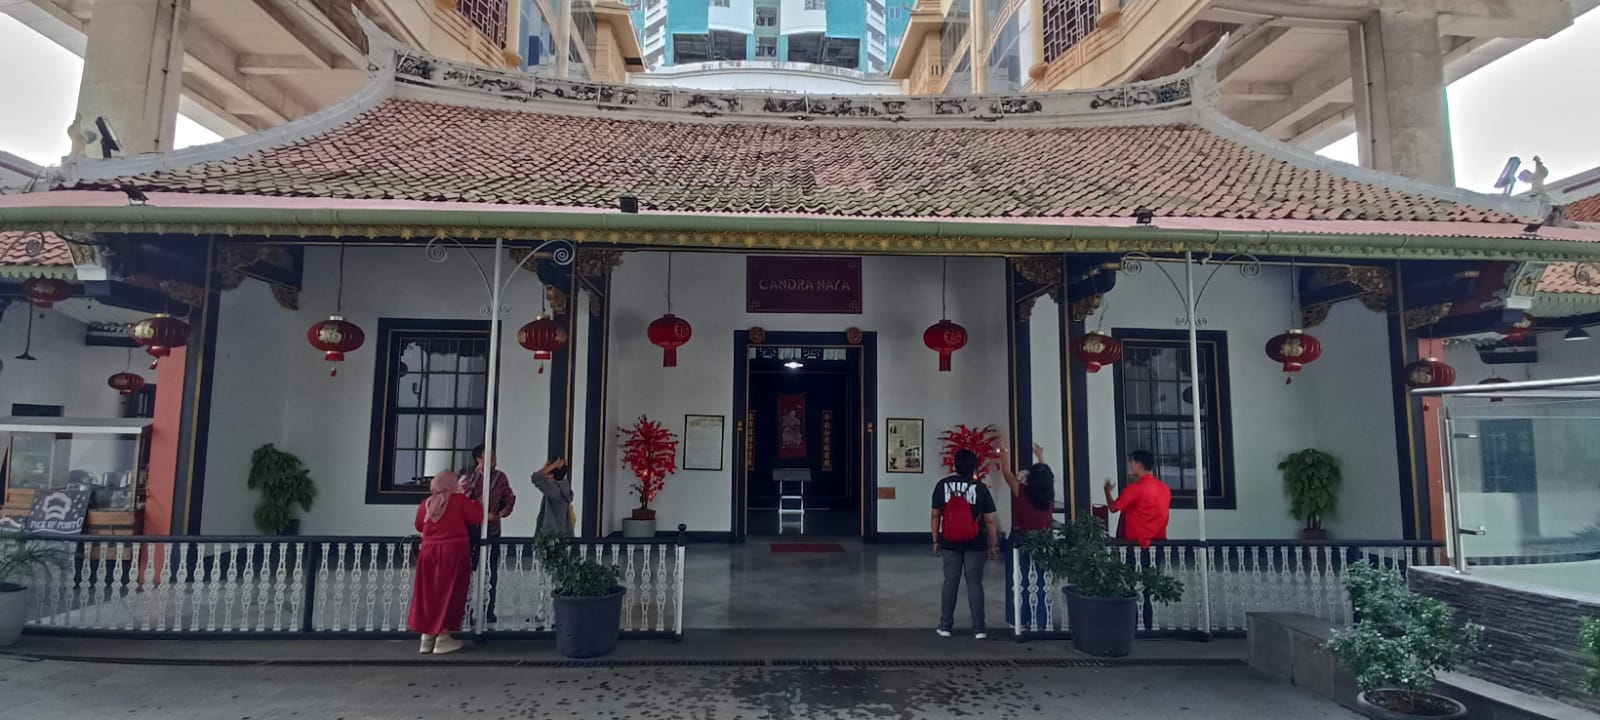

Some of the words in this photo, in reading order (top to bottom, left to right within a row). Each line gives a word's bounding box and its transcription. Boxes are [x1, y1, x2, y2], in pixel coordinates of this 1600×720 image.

[759, 279, 814, 291] CANDRA
[816, 279, 851, 291] NAYA
[30, 520, 46, 529] PICK
[47, 520, 57, 529] UP
[57, 520, 77, 530] POINT
